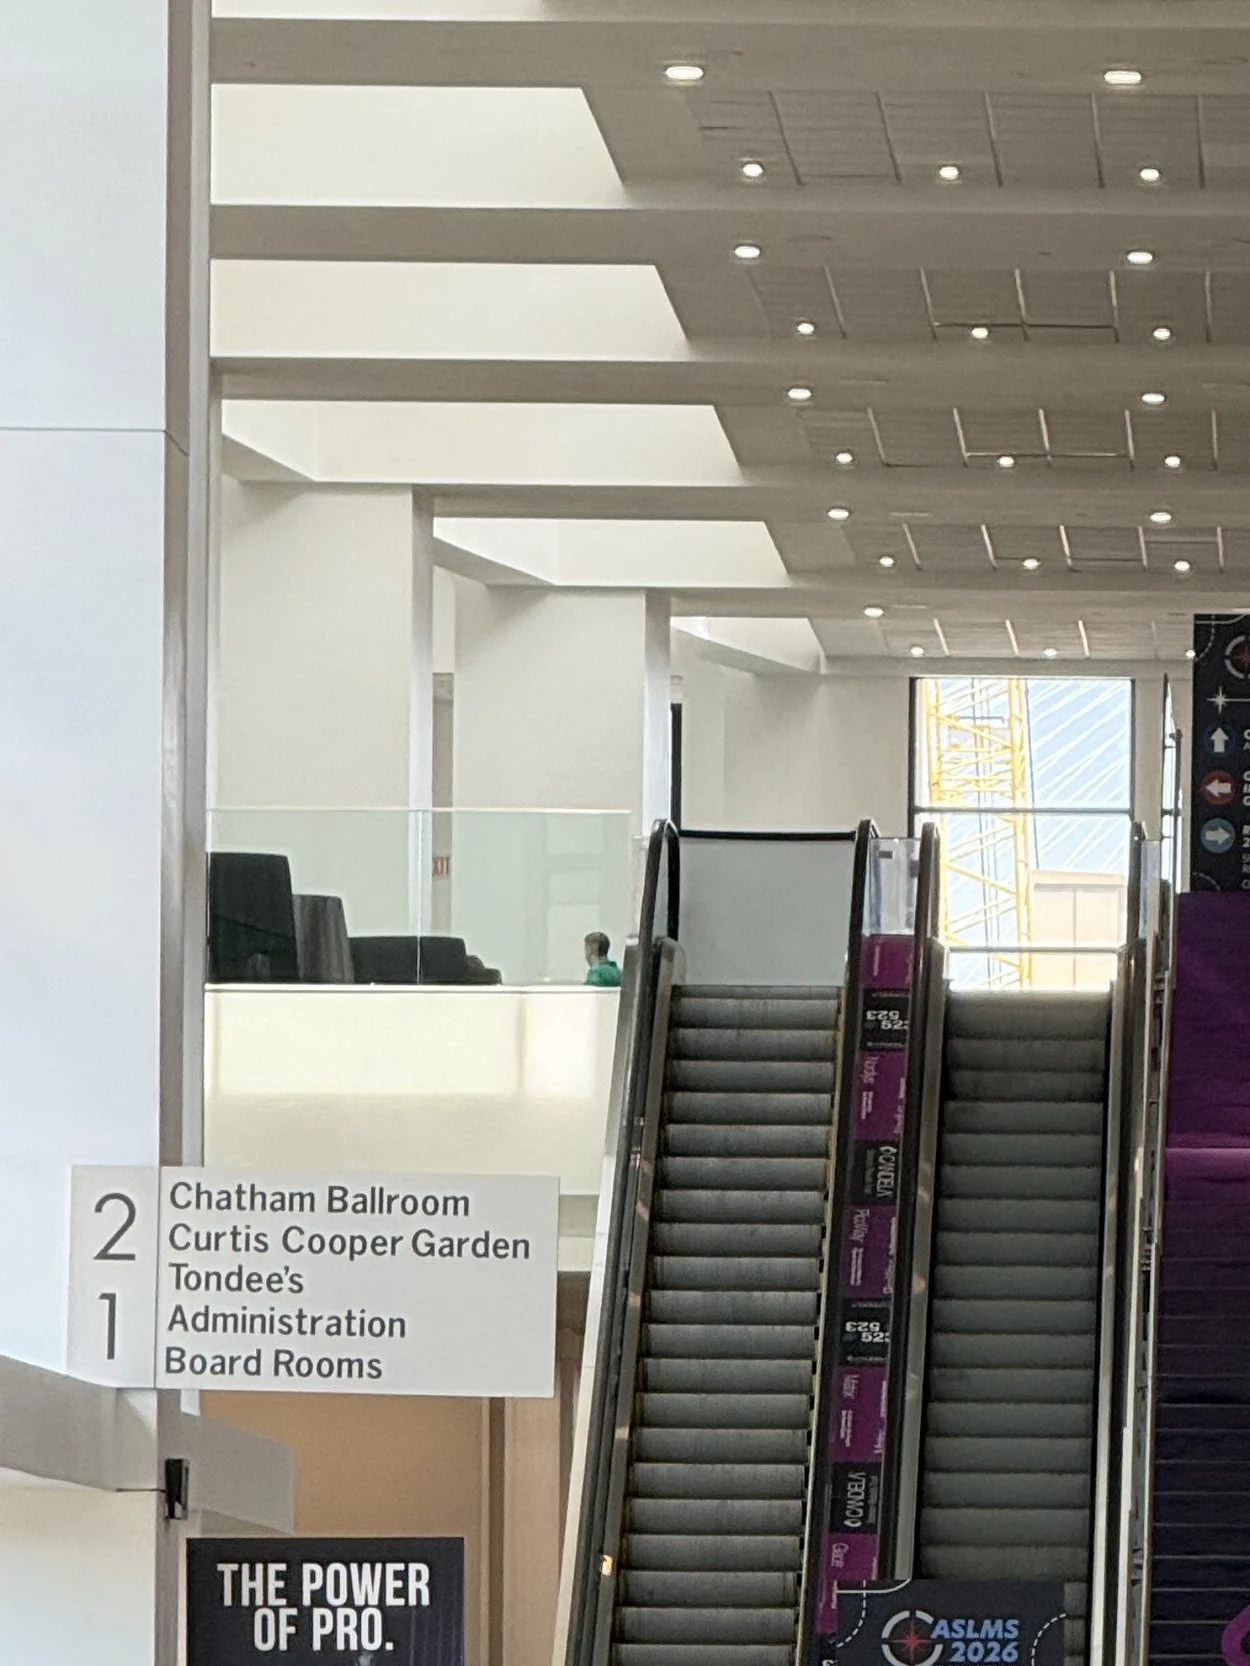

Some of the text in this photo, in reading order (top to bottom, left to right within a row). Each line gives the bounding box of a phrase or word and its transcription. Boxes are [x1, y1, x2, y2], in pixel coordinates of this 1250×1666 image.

[1243, 742, 1250, 751] A
[169, 1181, 471, 1217] Chatham Ballroom
[92, 1191, 138, 1262] 2
[168, 1223, 531, 1260] Curtis Cooper Garden
[168, 1263, 304, 1294] Tondee's
[98, 1291, 117, 1360] 1
[167, 1304, 407, 1338] Administration
[165, 1347, 383, 1380] Board Rooms
[217, 1563, 430, 1607] THE POWER
[254, 1608, 394, 1651] OF PRO.
[930, 1619, 1020, 1639] ASLMS
[950, 1641, 1019, 1663] 2026
